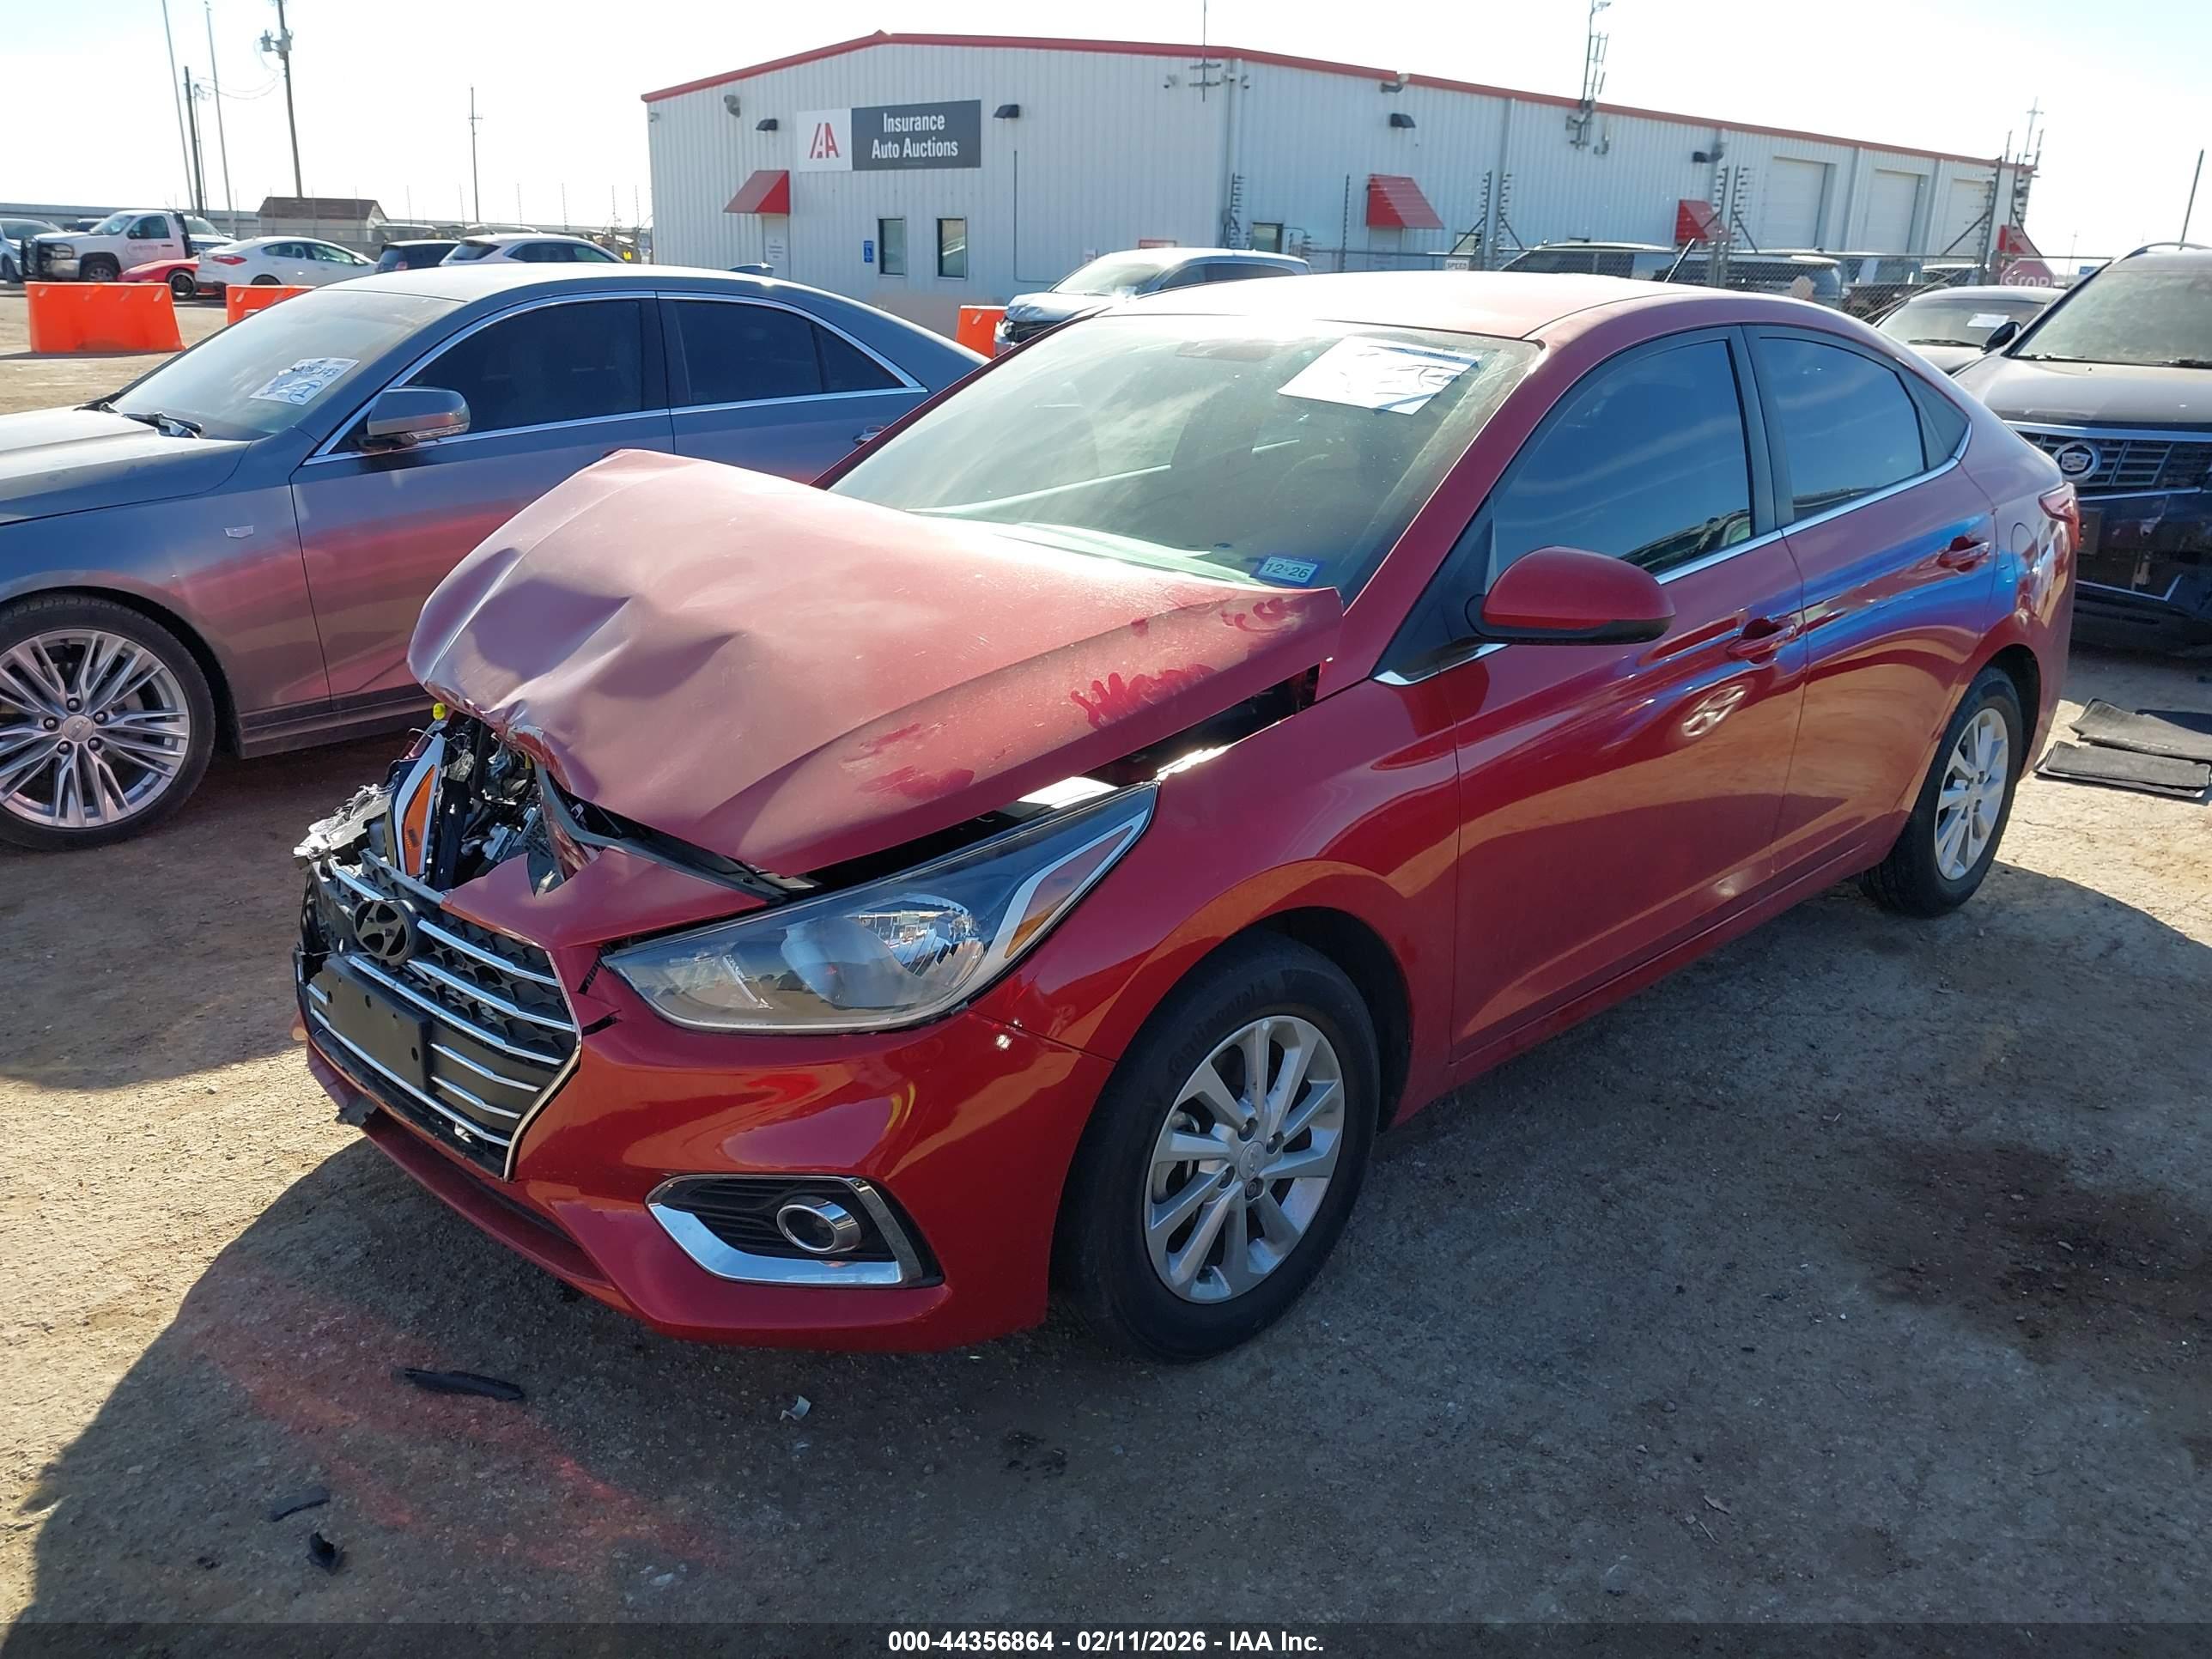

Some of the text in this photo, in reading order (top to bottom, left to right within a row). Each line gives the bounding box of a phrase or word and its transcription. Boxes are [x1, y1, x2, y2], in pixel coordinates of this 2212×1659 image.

[884, 113, 945, 133] Insurance
[872, 137, 958, 160] Auto Auctions
